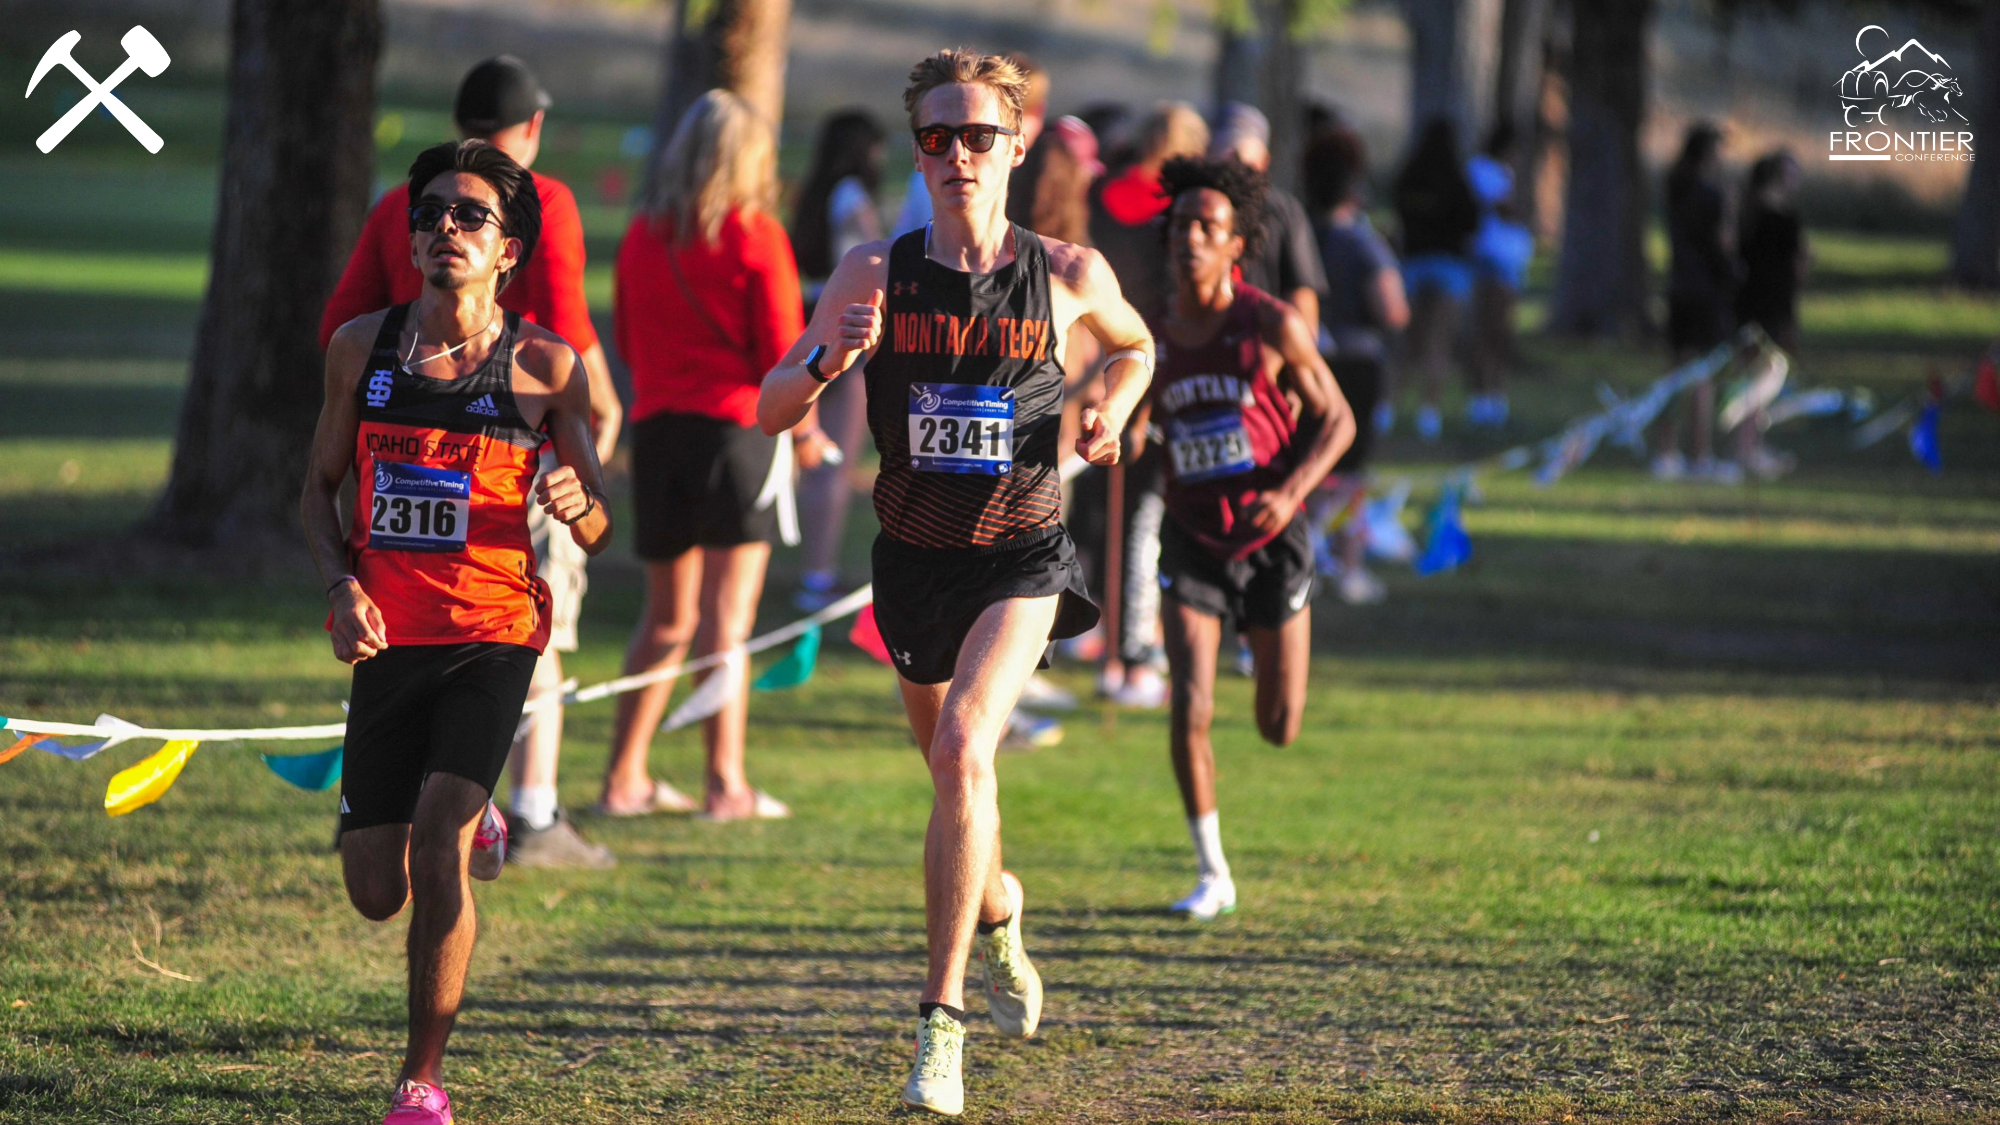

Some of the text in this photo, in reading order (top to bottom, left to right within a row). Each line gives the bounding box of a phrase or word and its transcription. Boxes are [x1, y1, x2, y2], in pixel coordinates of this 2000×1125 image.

[893, 312, 1048, 361] MONTANA TECH
[466, 405, 499, 417] adidas
[366, 433, 483, 464] IDAHO STATE
[919, 417, 1000, 457] 2341
[371, 495, 457, 537] 2316
